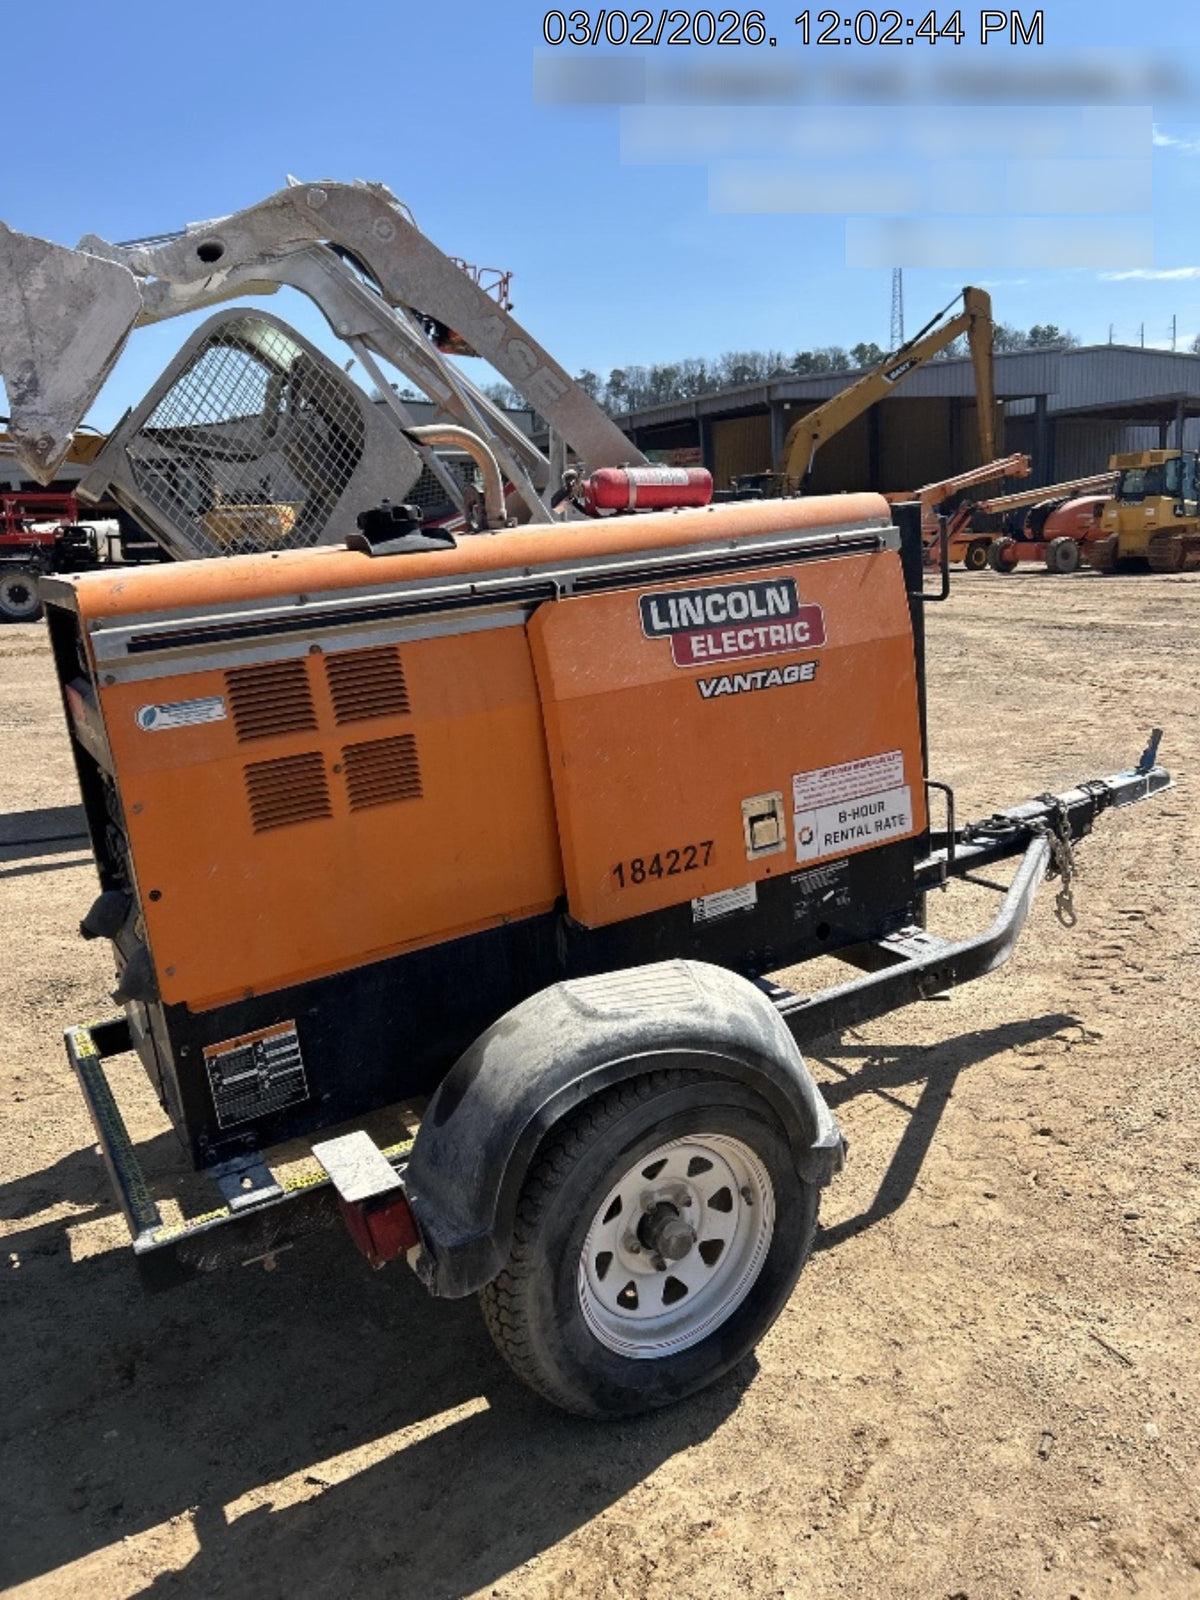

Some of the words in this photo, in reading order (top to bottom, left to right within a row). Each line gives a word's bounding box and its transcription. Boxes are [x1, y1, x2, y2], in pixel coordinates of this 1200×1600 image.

[650, 586, 791, 631] LINCOLN
[690, 621, 811, 658] ELECTRIC
[698, 662, 817, 699] VANTAGE
[824, 824, 872, 846] RENTAL
[874, 813, 907, 832] RATE
[838, 801, 885, 824] 8-HOUR
[613, 840, 714, 888] 184227
